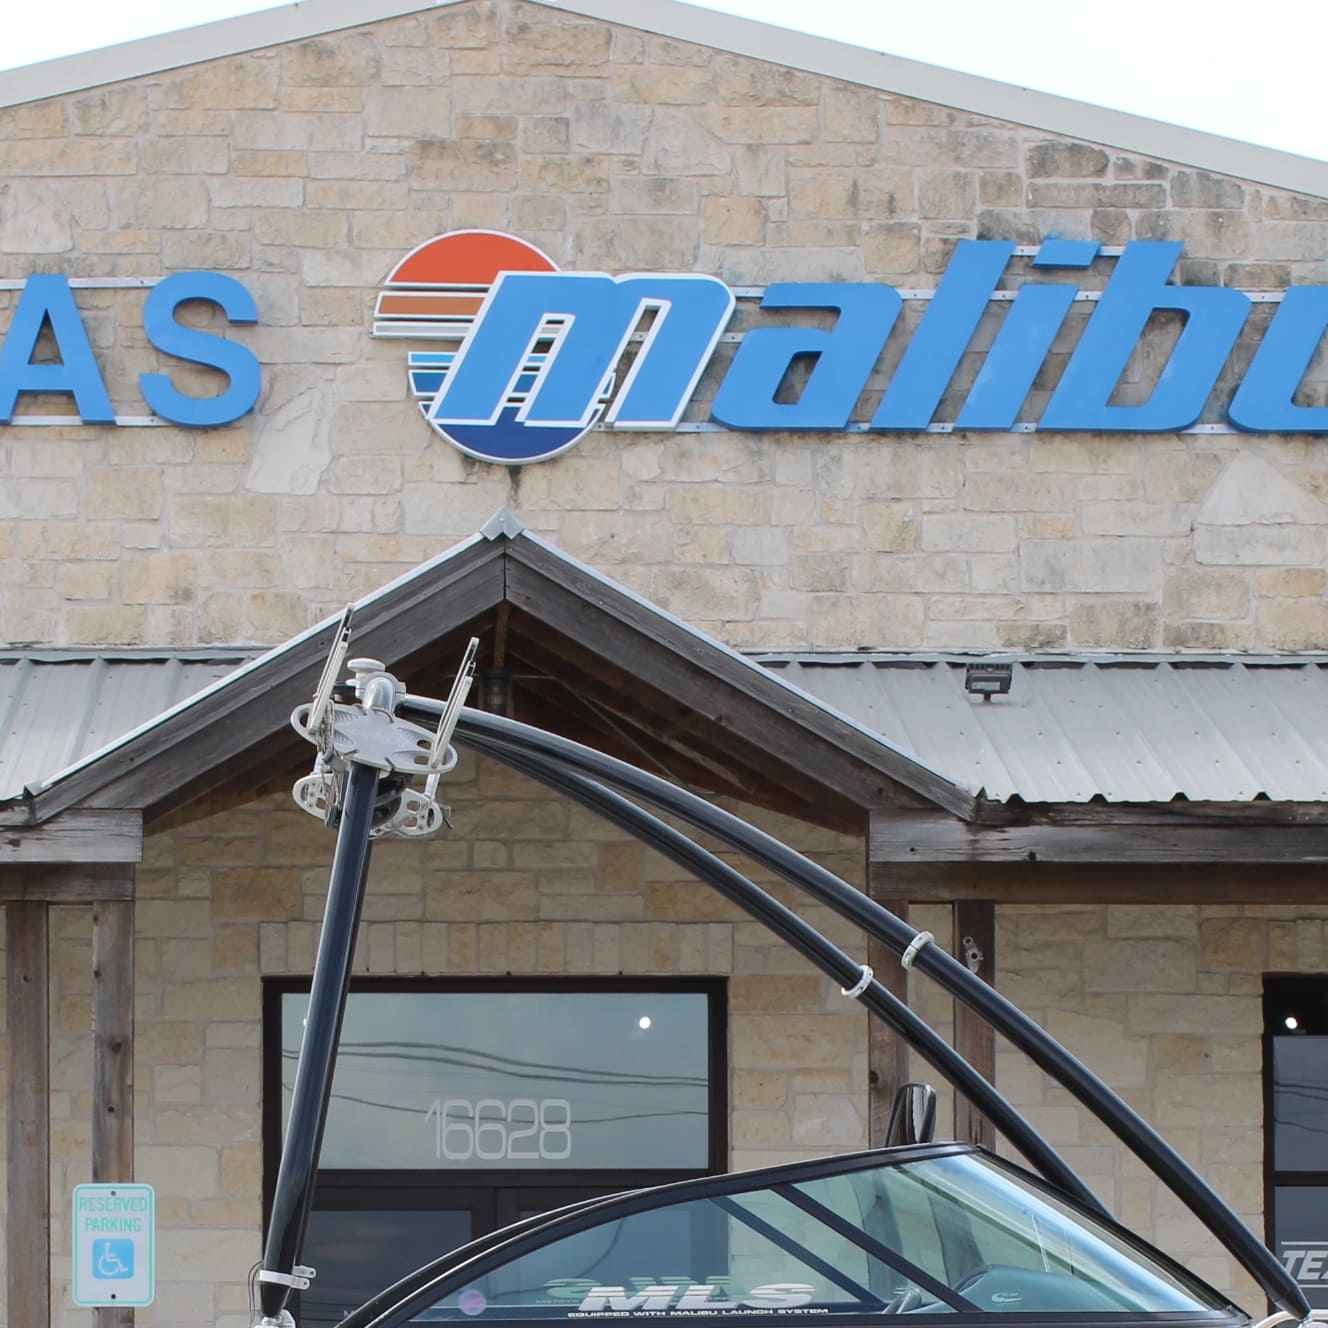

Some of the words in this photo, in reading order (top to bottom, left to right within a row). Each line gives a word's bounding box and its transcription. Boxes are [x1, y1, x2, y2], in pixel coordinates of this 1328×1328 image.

[424, 1099, 572, 1160] 16628
[78, 1197, 148, 1212] RESERVED
[85, 1218, 143, 1233] PARKING
[578, 1283, 817, 1311] MLS
